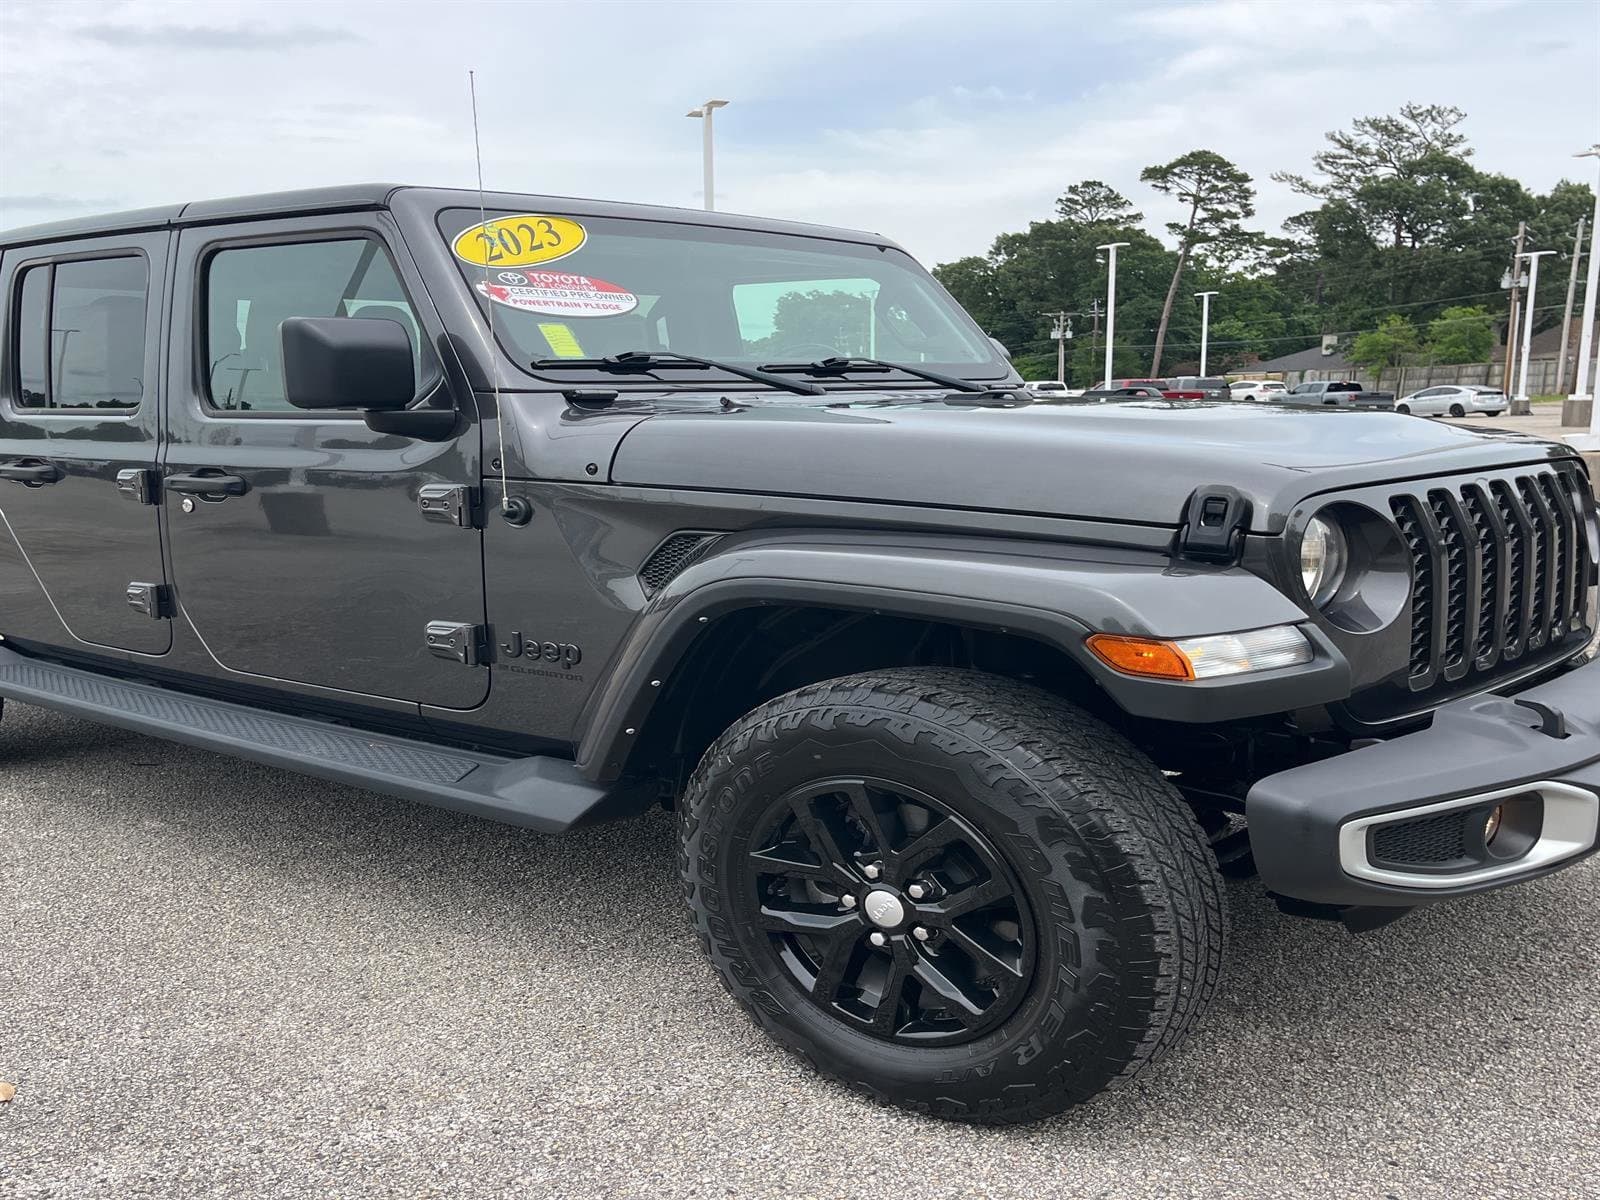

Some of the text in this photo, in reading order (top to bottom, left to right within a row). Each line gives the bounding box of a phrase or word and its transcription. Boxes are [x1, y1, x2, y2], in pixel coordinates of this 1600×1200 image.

[476, 219, 562, 263] 2023
[529, 272, 592, 286] TOYOTA
[510, 287, 634, 302] CERTIFIED PRE-OWNED
[512, 298, 622, 311] POWERTRAIN PLEDGE
[500, 630, 582, 670] Jeep
[510, 665, 584, 682] GLADIATOR
[696, 751, 791, 1016] BRIDGESTONE
[1003, 831, 1083, 1067] DUELER
